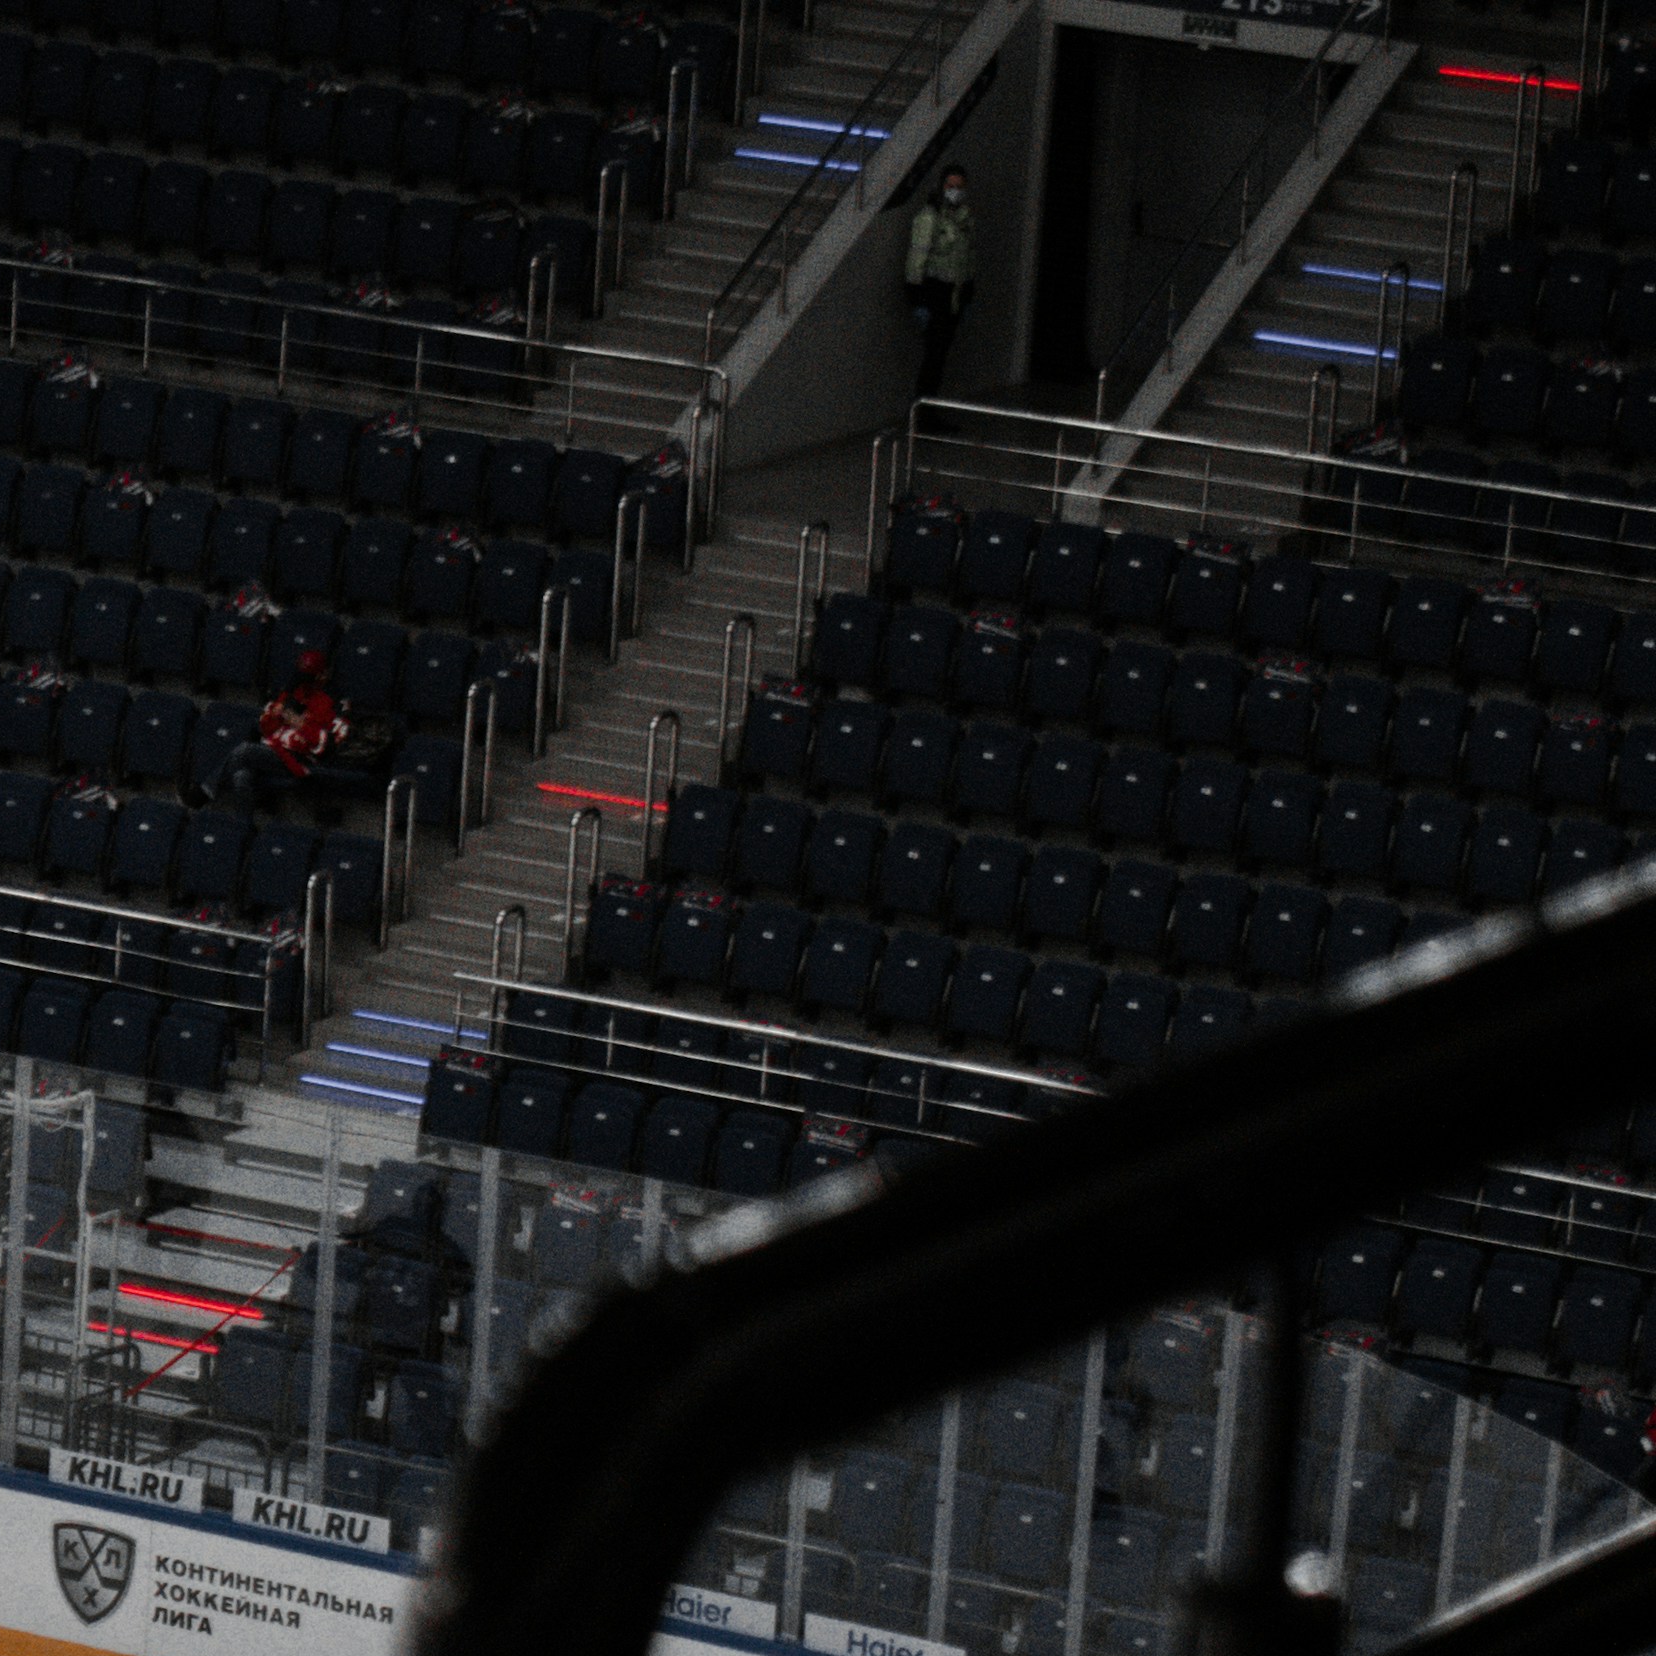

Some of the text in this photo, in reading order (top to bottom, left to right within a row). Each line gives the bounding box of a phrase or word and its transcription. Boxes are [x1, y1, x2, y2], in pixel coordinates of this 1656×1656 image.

[68, 1456, 184, 1504] KHL.RU
[252, 1496, 371, 1544] KHL.RU
[153, 1580, 302, 1630] ХОККЕЙНАЯ
[154, 1555, 394, 1625] КОНТИНЕНТАЛЬНАЯ
[151, 1606, 213, 1637] ЛИГА
